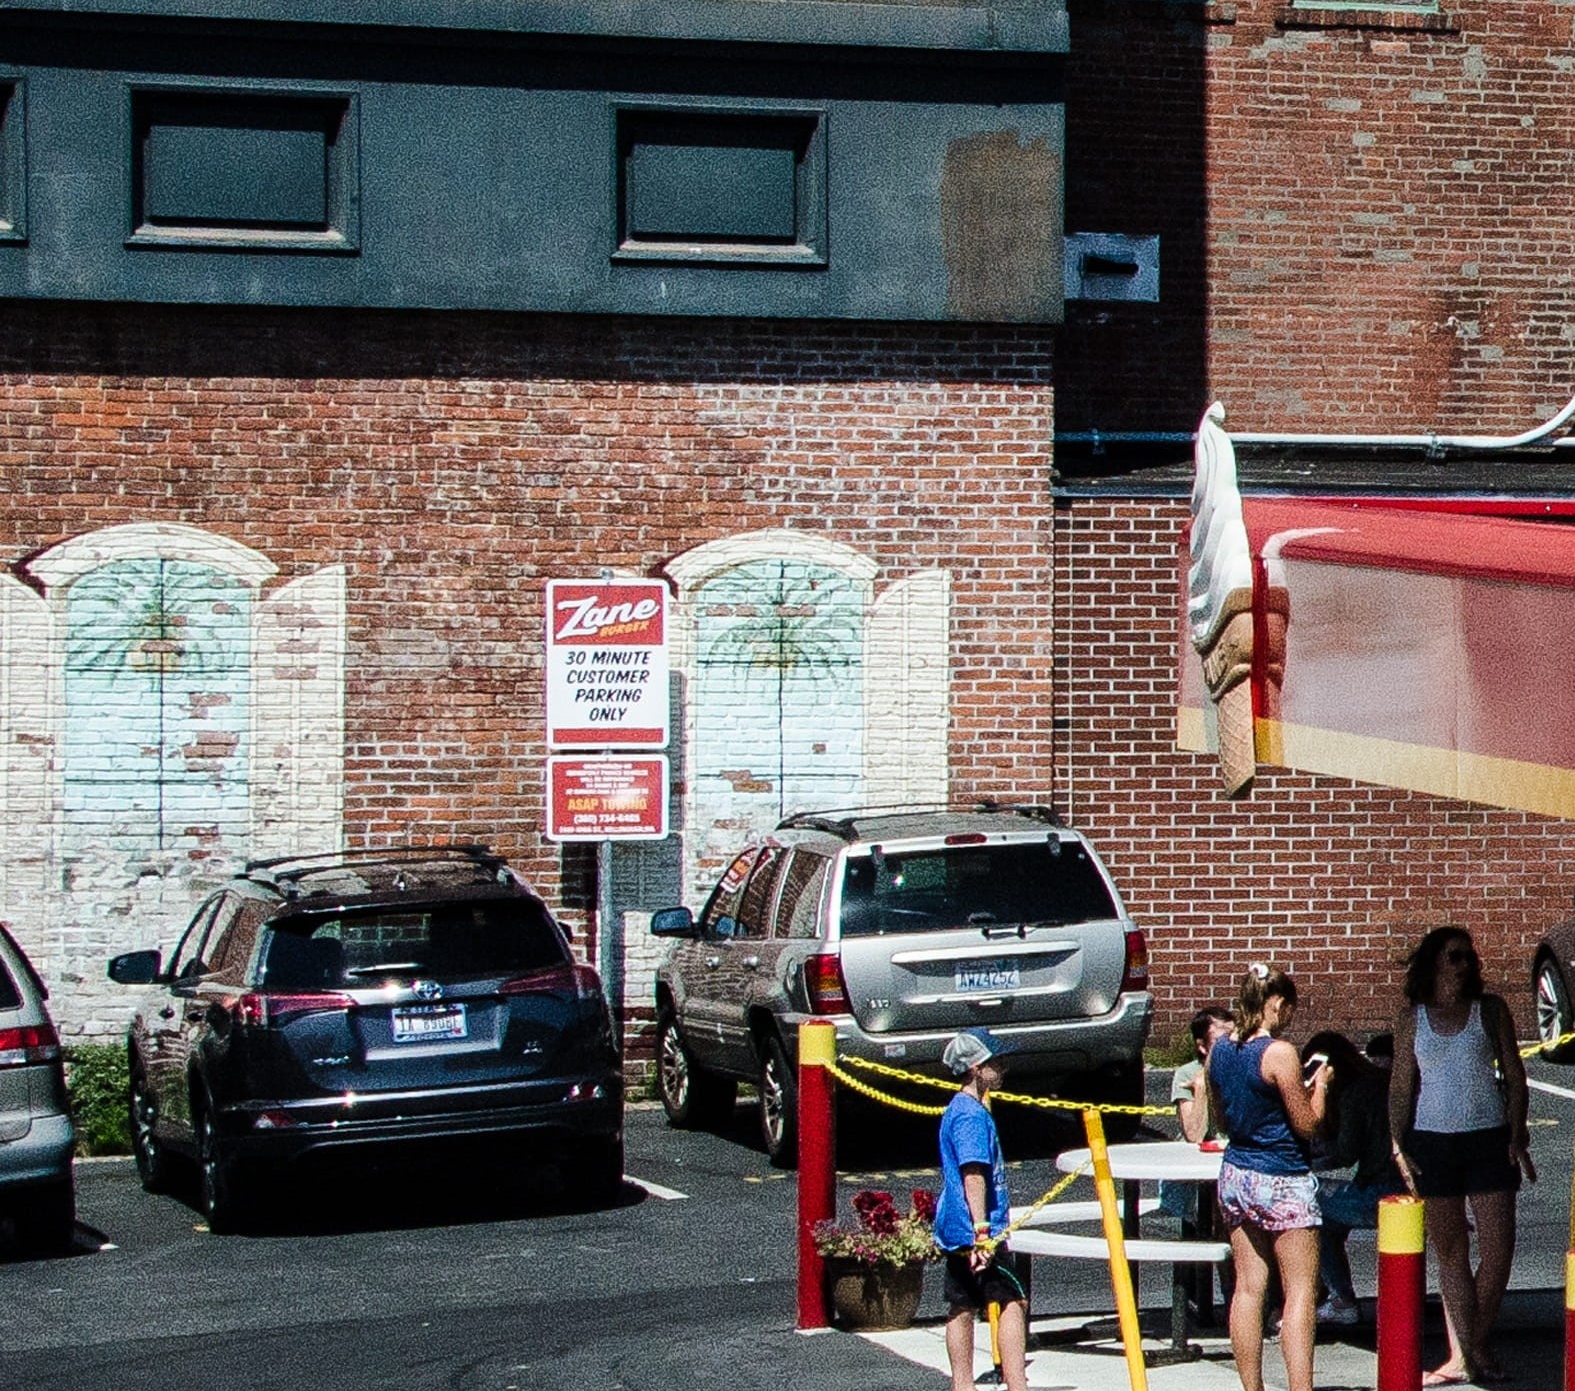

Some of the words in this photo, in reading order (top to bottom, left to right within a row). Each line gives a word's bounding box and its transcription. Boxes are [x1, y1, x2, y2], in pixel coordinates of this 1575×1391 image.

[556, 595, 660, 640] Zane
[566, 651, 586, 665] 30
[591, 651, 652, 665] MINUTE
[567, 670, 650, 684] CUSTOMER
[575, 688, 642, 703] PARKING
[589, 707, 627, 721] ONLY
[568, 798, 598, 810] ASAP
